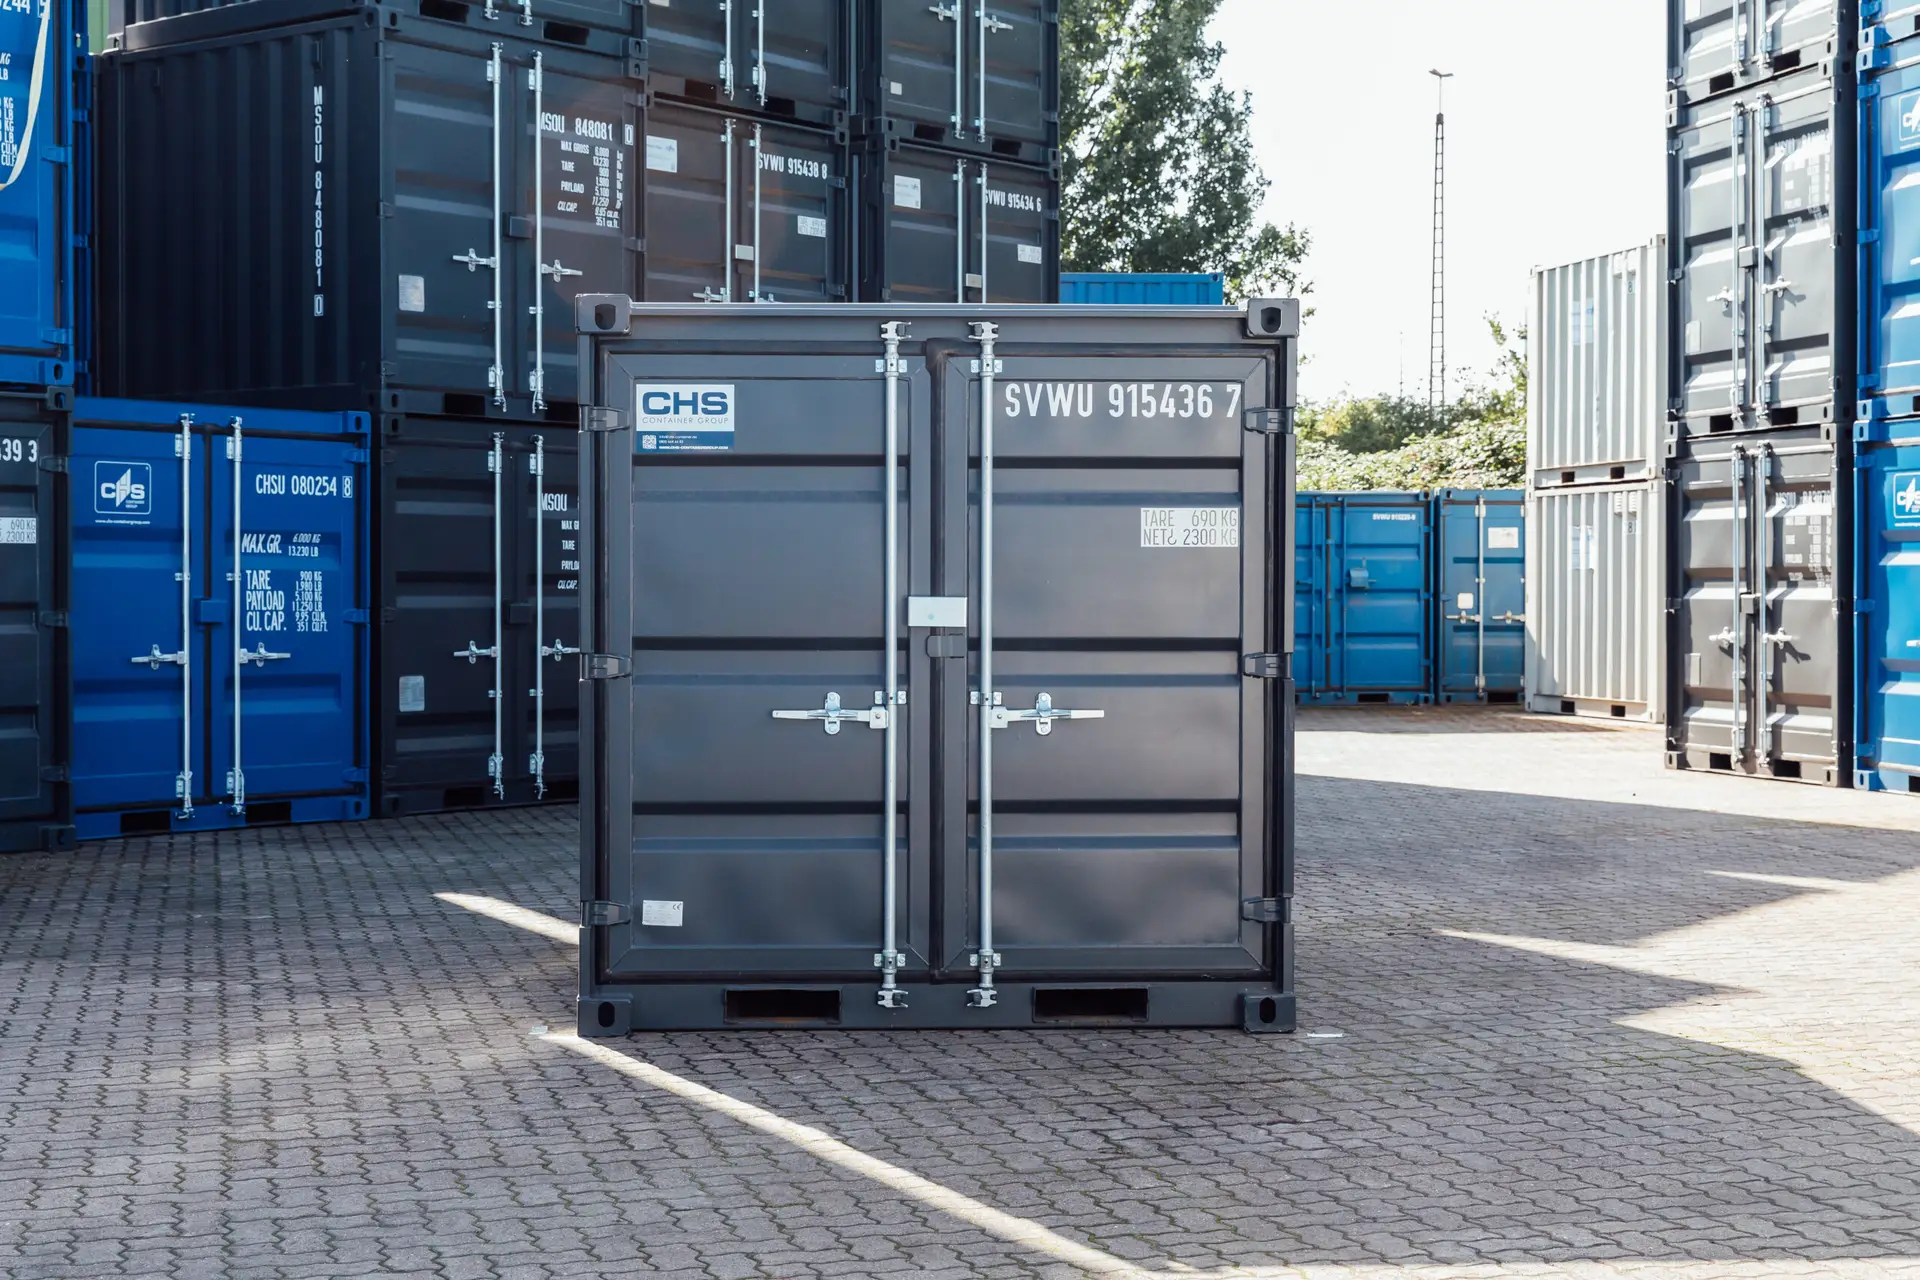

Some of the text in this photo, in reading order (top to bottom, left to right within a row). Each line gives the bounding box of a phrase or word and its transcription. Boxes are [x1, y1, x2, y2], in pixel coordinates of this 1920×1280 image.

[4, 97, 13, 109] KG
[4, 109, 13, 121] LB
[5, 120, 14, 132] KG
[314, 86, 322, 163] MSOU
[575, 117, 613, 141] 848081
[5, 132, 14, 144] LB
[561, 160, 575, 172] TARE
[788, 158, 819, 178] 915438
[822, 164, 827, 179] 8
[1008, 193, 1034, 211] 915434
[1036, 198, 1041, 212] 6
[643, 392, 728, 415] CHS
[1005, 383, 1241, 418] SVWU 915436 7
[0, 439, 37, 462] 39 3
[256, 474, 351, 497] CHSU 080254 8
[1143, 510, 1237, 526] TARE 690 KG
[11, 520, 36, 530] 690 KG
[561, 520, 572, 530] MAX
[7, 531, 36, 542] 2300 KG
[312, 534, 321, 543] KG
[1183, 529, 1217, 545] 2300
[1221, 529, 1237, 545] KG
[562, 540, 575, 550] TARE
[288, 546, 318, 557] 13.230 LB
[246, 570, 322, 590] TARE 900 KG
[314, 581, 322, 591] LB
[246, 591, 284, 611] PAYLOAD
[314, 592, 322, 602] KG
[314, 602, 322, 612] LB
[297, 622, 309, 632] 351
